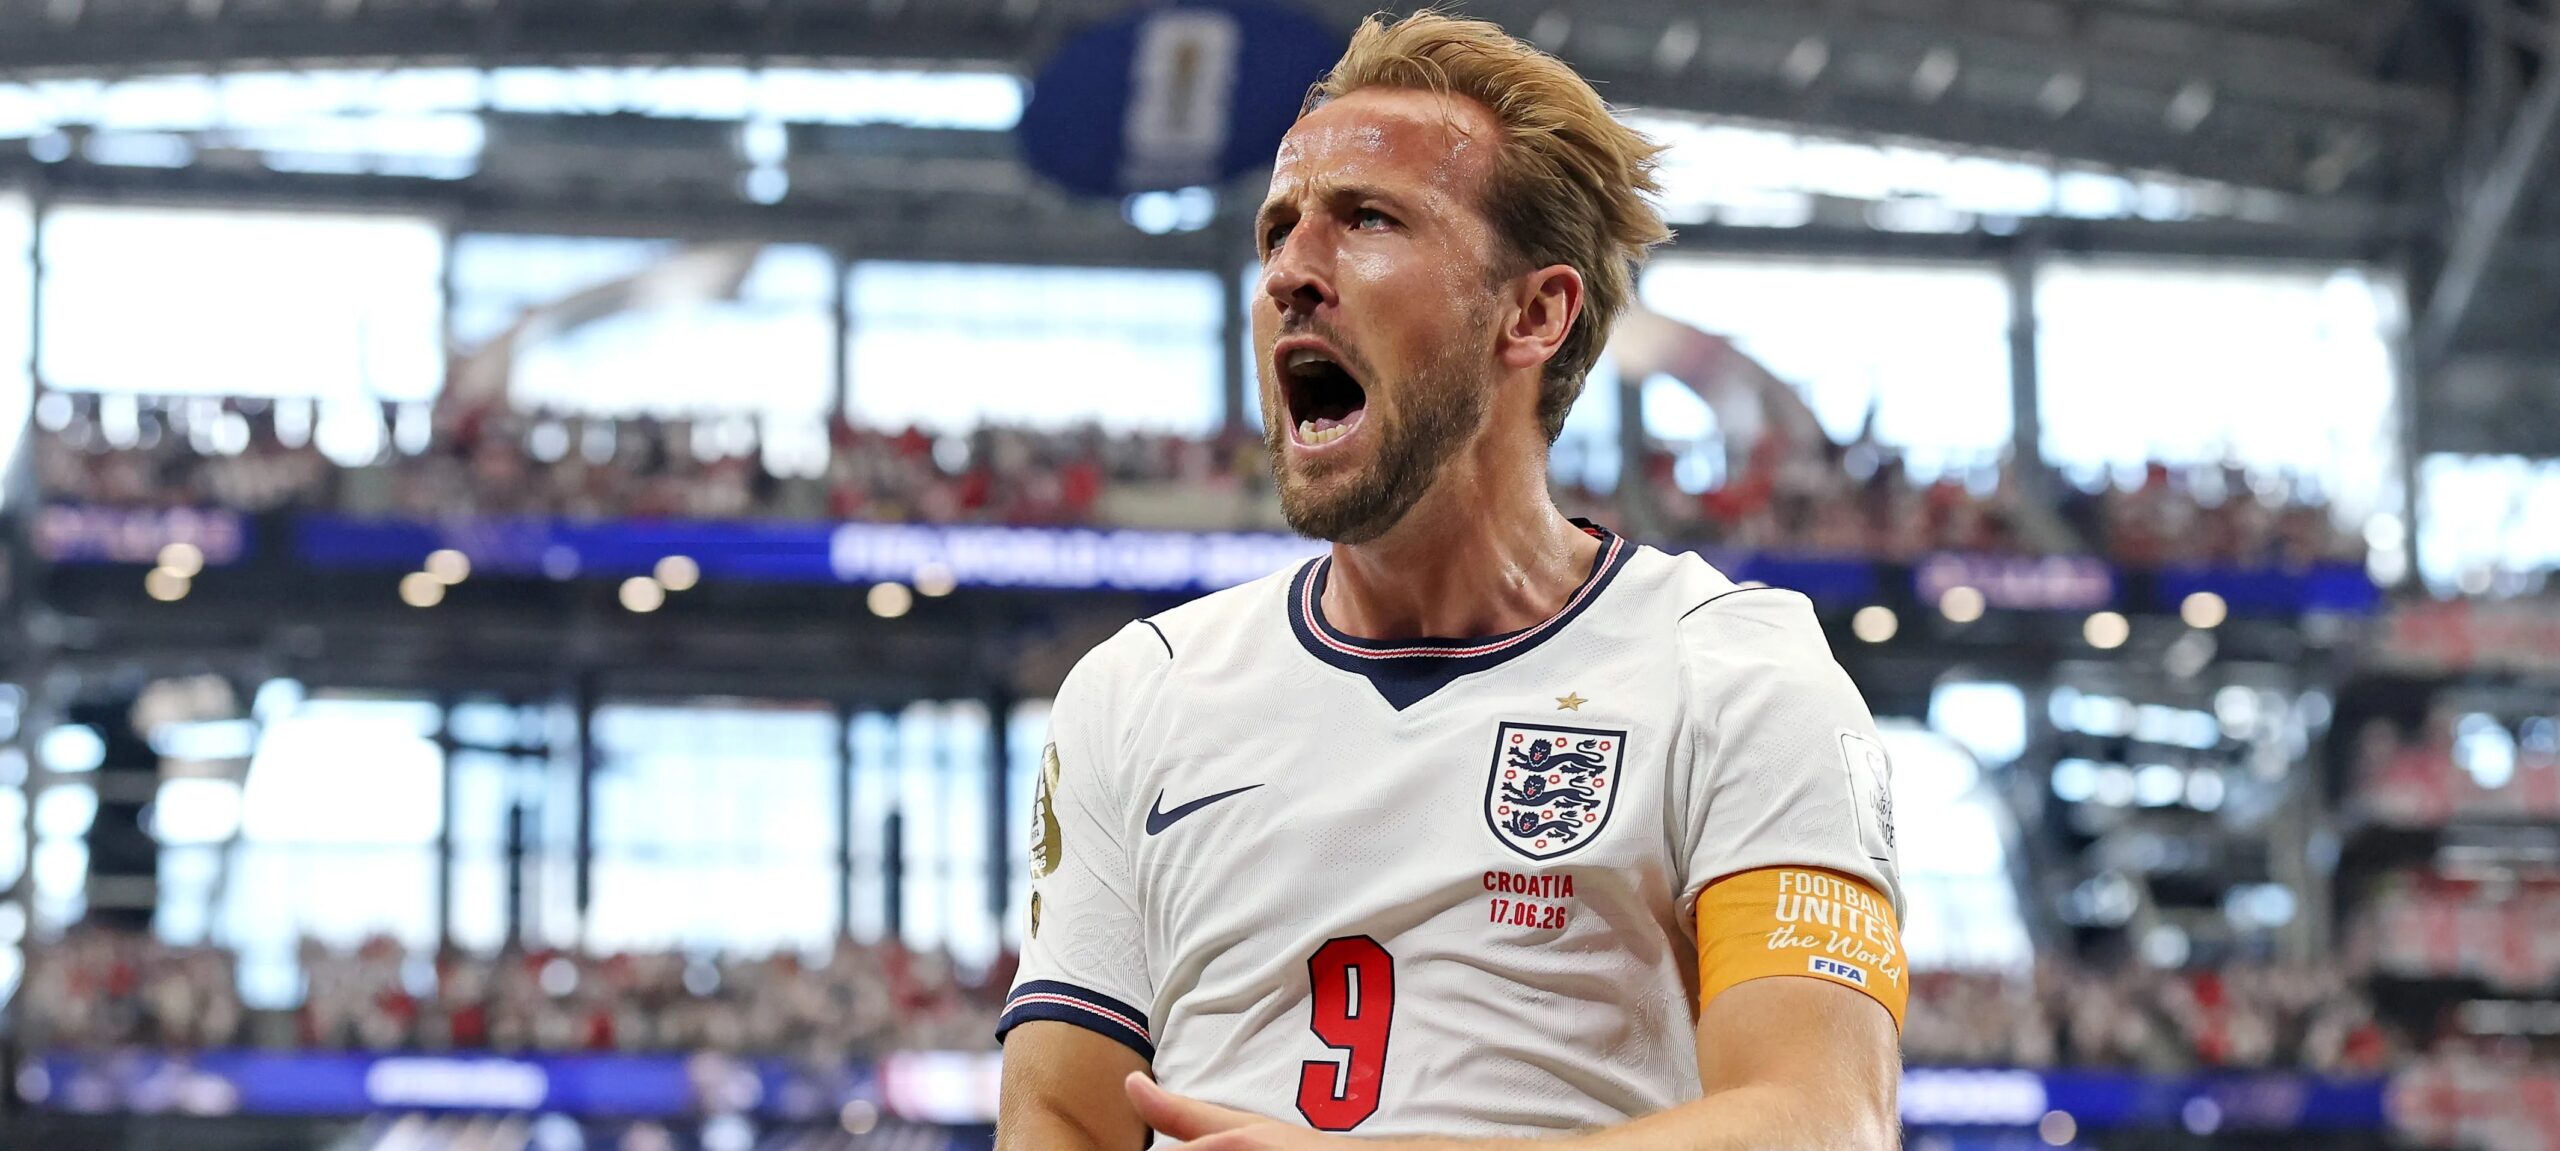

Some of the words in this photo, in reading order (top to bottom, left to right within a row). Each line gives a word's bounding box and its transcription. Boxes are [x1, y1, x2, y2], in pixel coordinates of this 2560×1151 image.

[1483, 871, 1574, 898] CROATIA
[1490, 898, 1566, 929] 17.06.26
[1779, 871, 1893, 931] FOOTBALL
[1776, 894, 1896, 955] UNITES
[1765, 924, 1820, 950] the
[1826, 930, 1901, 989] World
[1814, 959, 1863, 983] FIFA
[1295, 934, 1395, 1131] 9
